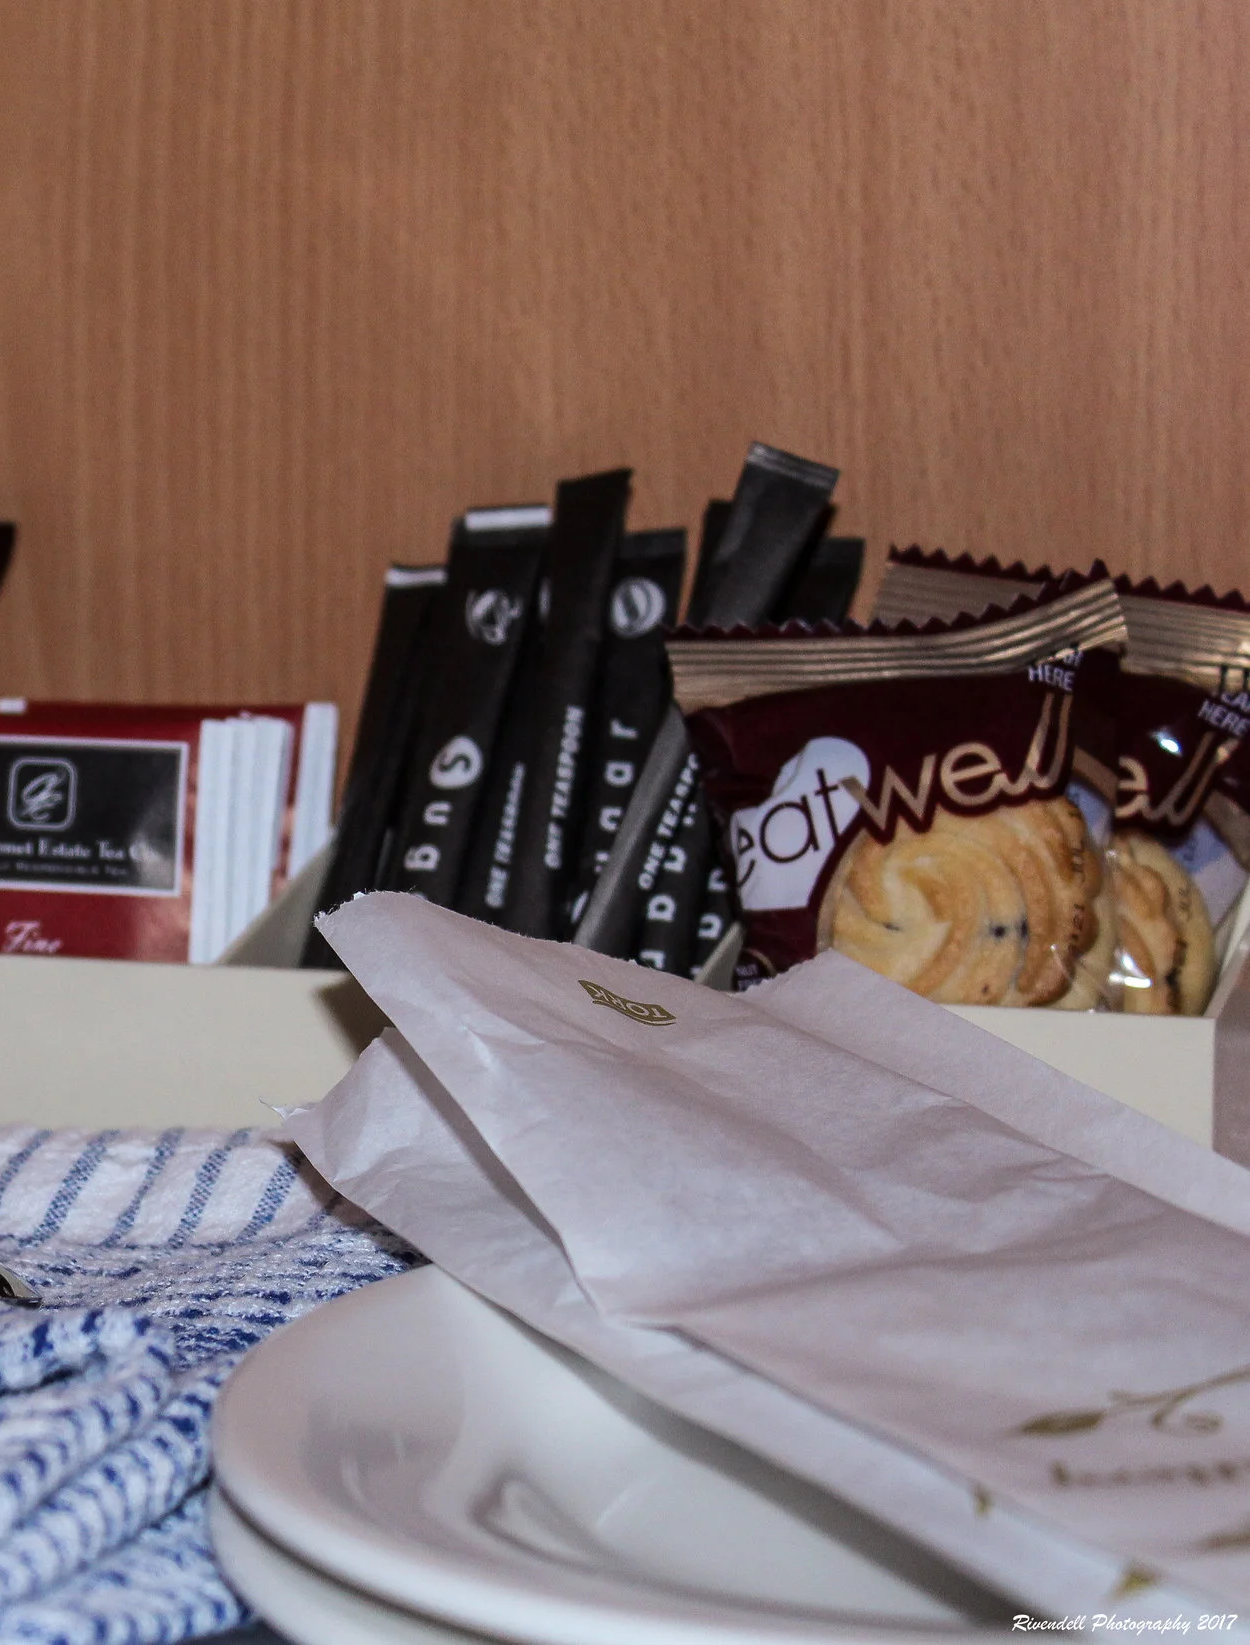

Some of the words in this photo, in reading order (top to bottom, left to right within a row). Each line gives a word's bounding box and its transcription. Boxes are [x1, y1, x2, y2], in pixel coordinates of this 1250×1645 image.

[551, 705, 585, 819] TEASPOON
[95, 839, 126, 860] Tea
[638, 841, 667, 890] ONE
[586, 984, 668, 1019] TORK
